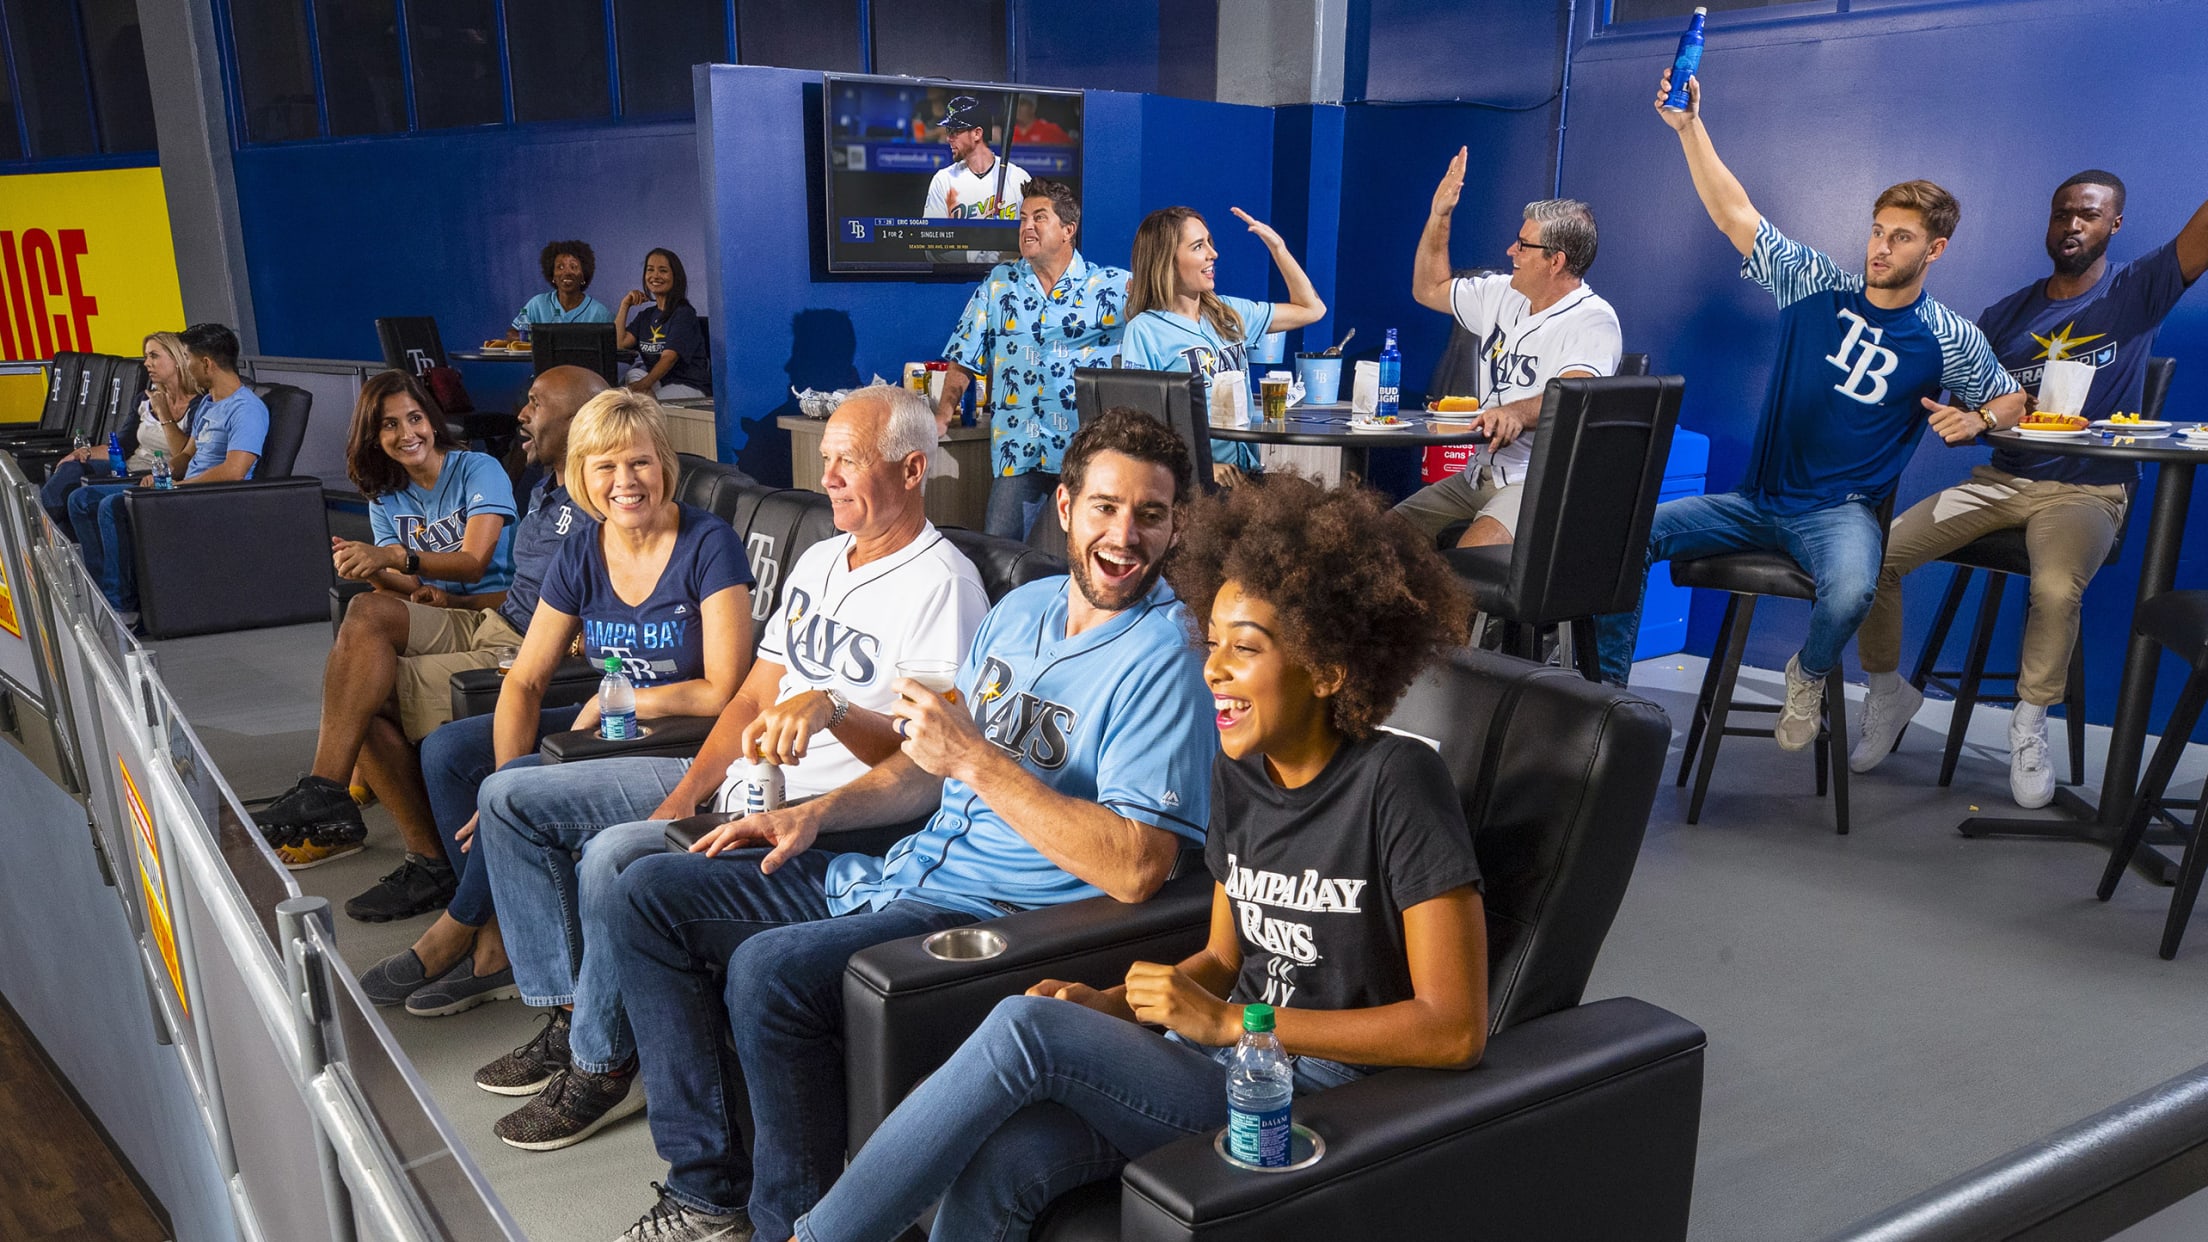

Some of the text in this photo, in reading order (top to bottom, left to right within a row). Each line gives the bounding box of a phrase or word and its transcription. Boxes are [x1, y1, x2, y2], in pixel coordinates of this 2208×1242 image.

[848, 220, 866, 239] TB
[883, 230, 887, 239] 1
[898, 230, 904, 239] 2
[920, 231, 938, 239] SINGLE
[939, 231, 945, 239] IN
[1180, 343, 1247, 387] RAY
[1481, 322, 1538, 392] RAYS
[1825, 306, 1899, 405] TB
[1379, 387, 1398, 395] BUD
[1379, 395, 1399, 403] IGHT
[1443, 451, 1466, 459] cans
[555, 504, 573, 535] TB
[747, 532, 779, 621] TB
[586, 619, 687, 649] AMPA BAY
[784, 586, 881, 687] RAYS
[968, 656, 1079, 770] RAYS
[747, 783, 765, 814] ite
[1225, 853, 1367, 913] TAMPA BAY
[1237, 900, 1318, 964] RAYS
[1260, 977, 1296, 1008] NY
